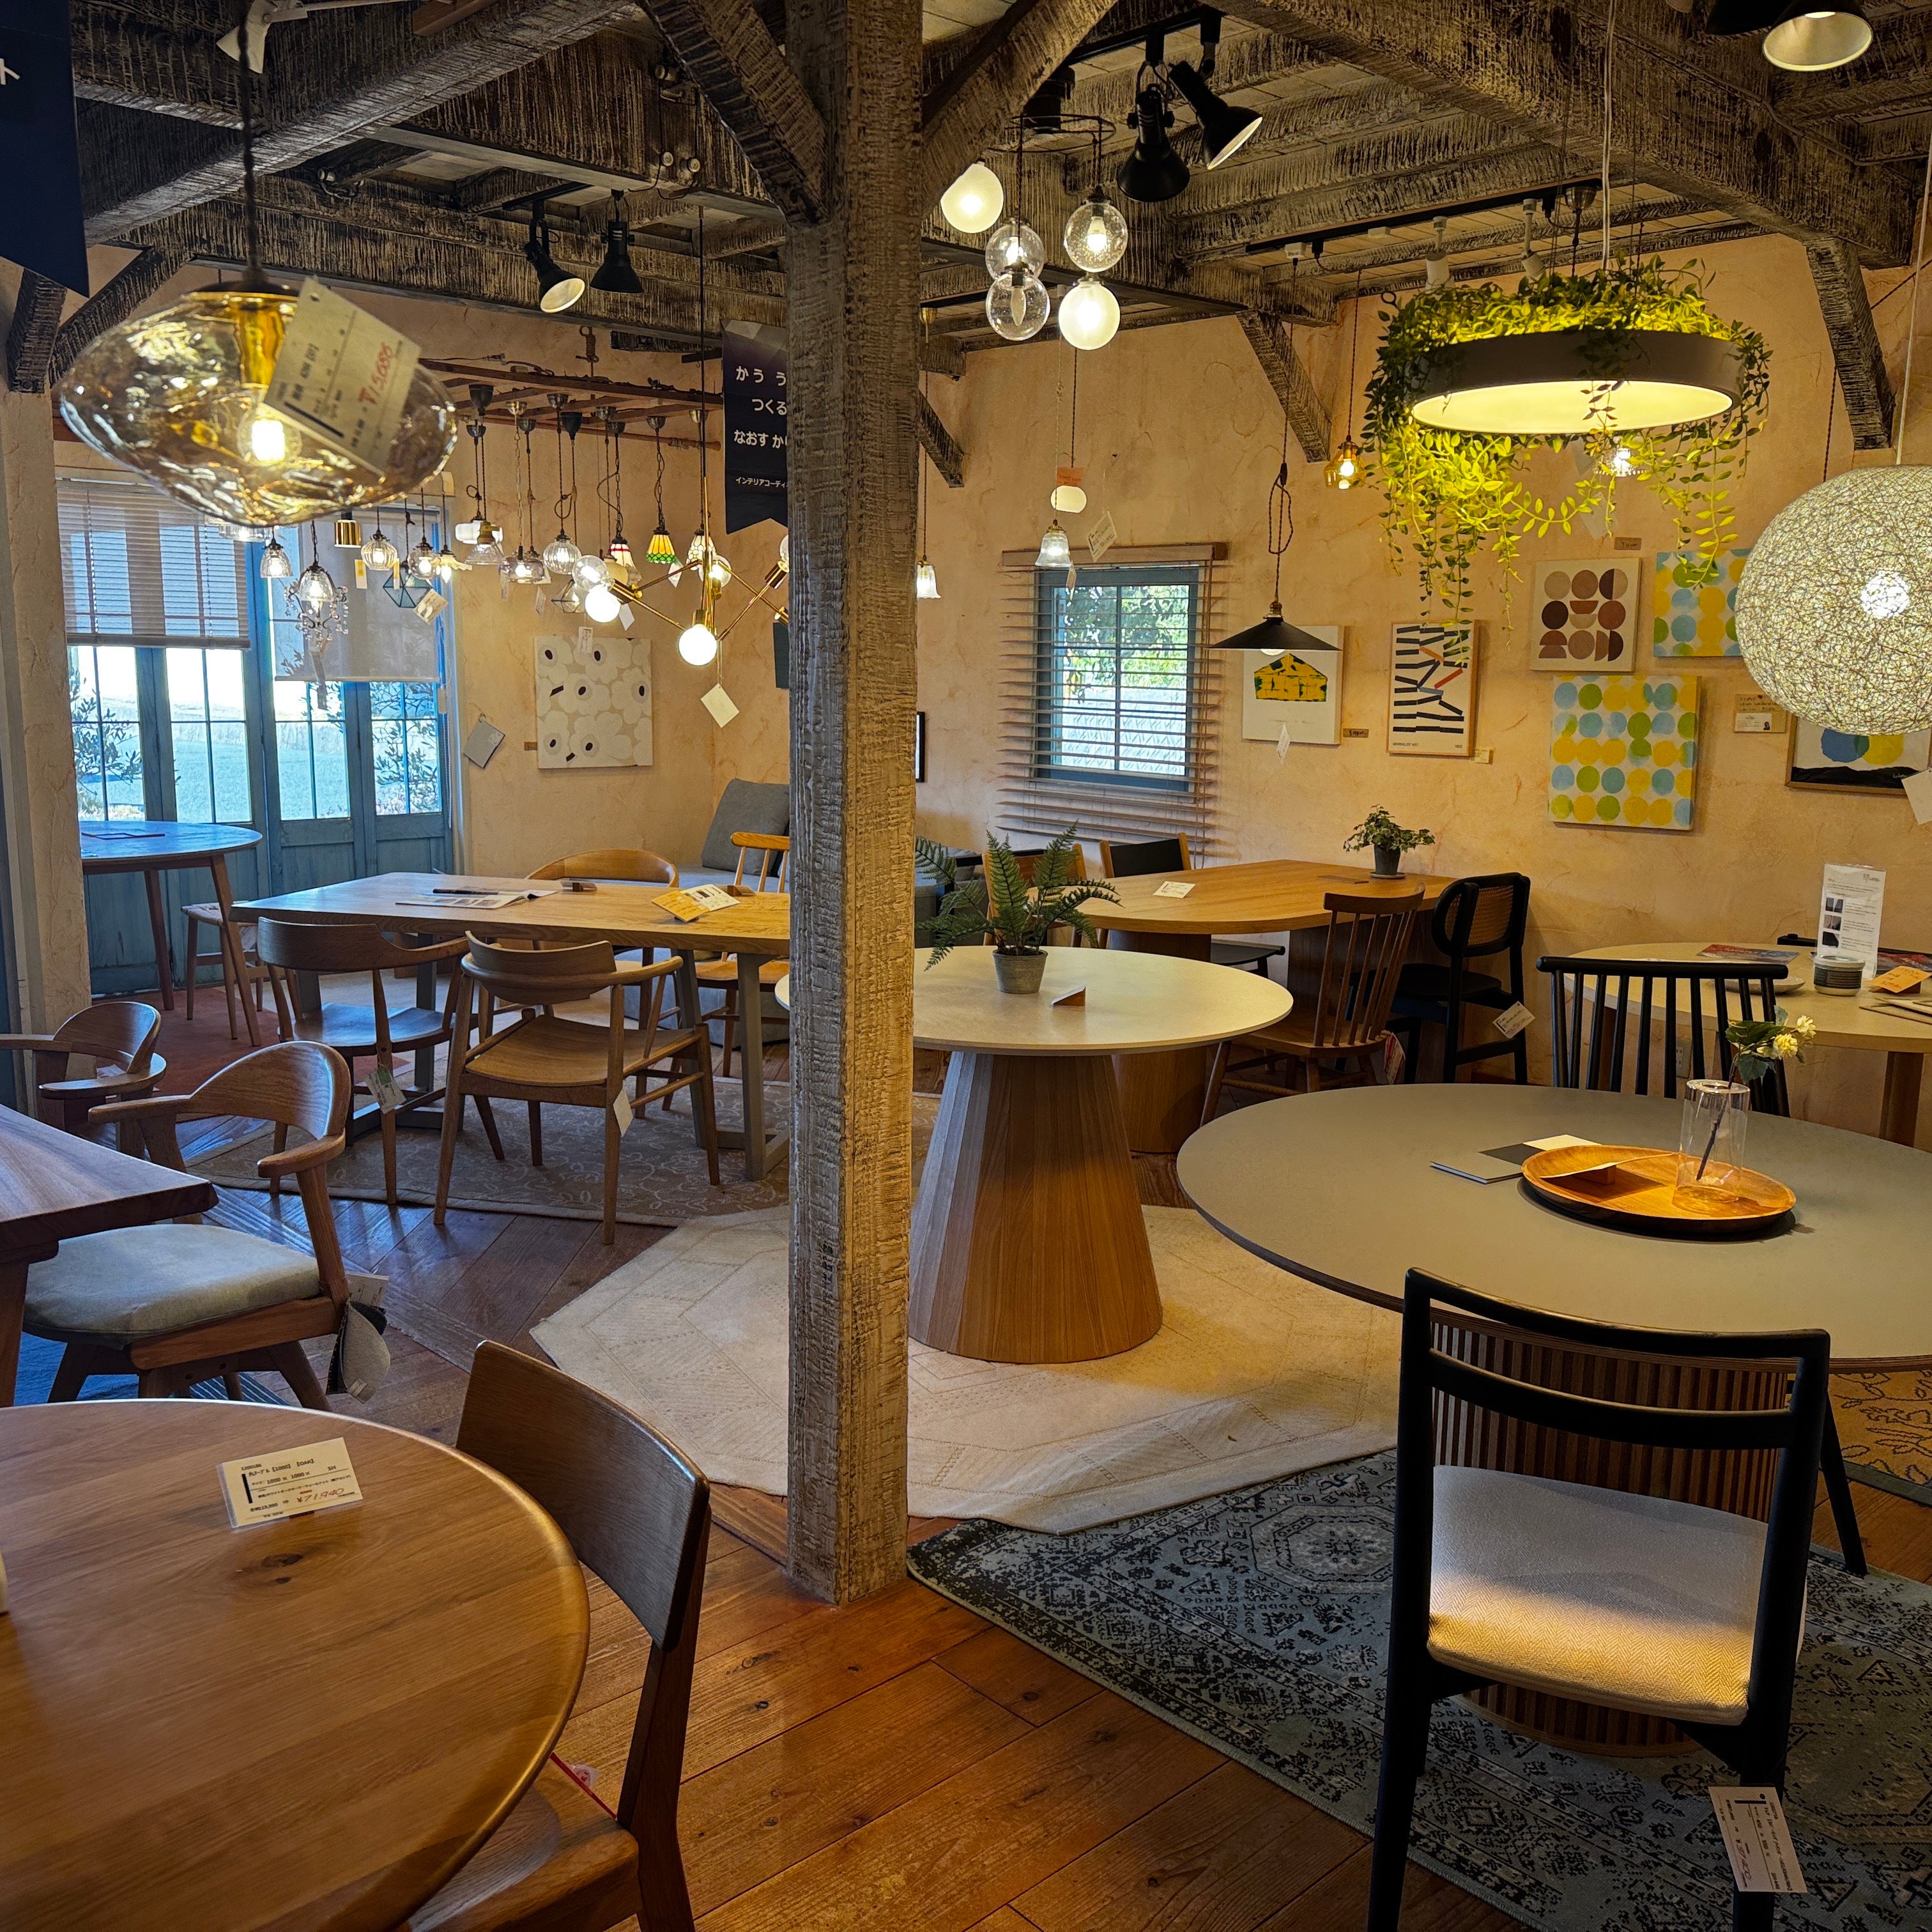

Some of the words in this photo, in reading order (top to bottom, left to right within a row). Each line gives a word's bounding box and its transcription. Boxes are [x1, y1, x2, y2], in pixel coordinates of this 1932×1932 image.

[736, 365, 764, 383] かう
[751, 399, 787, 415] つくる
[733, 429, 769, 447] なおす
[735, 476, 788, 488] インテリアコーディ
